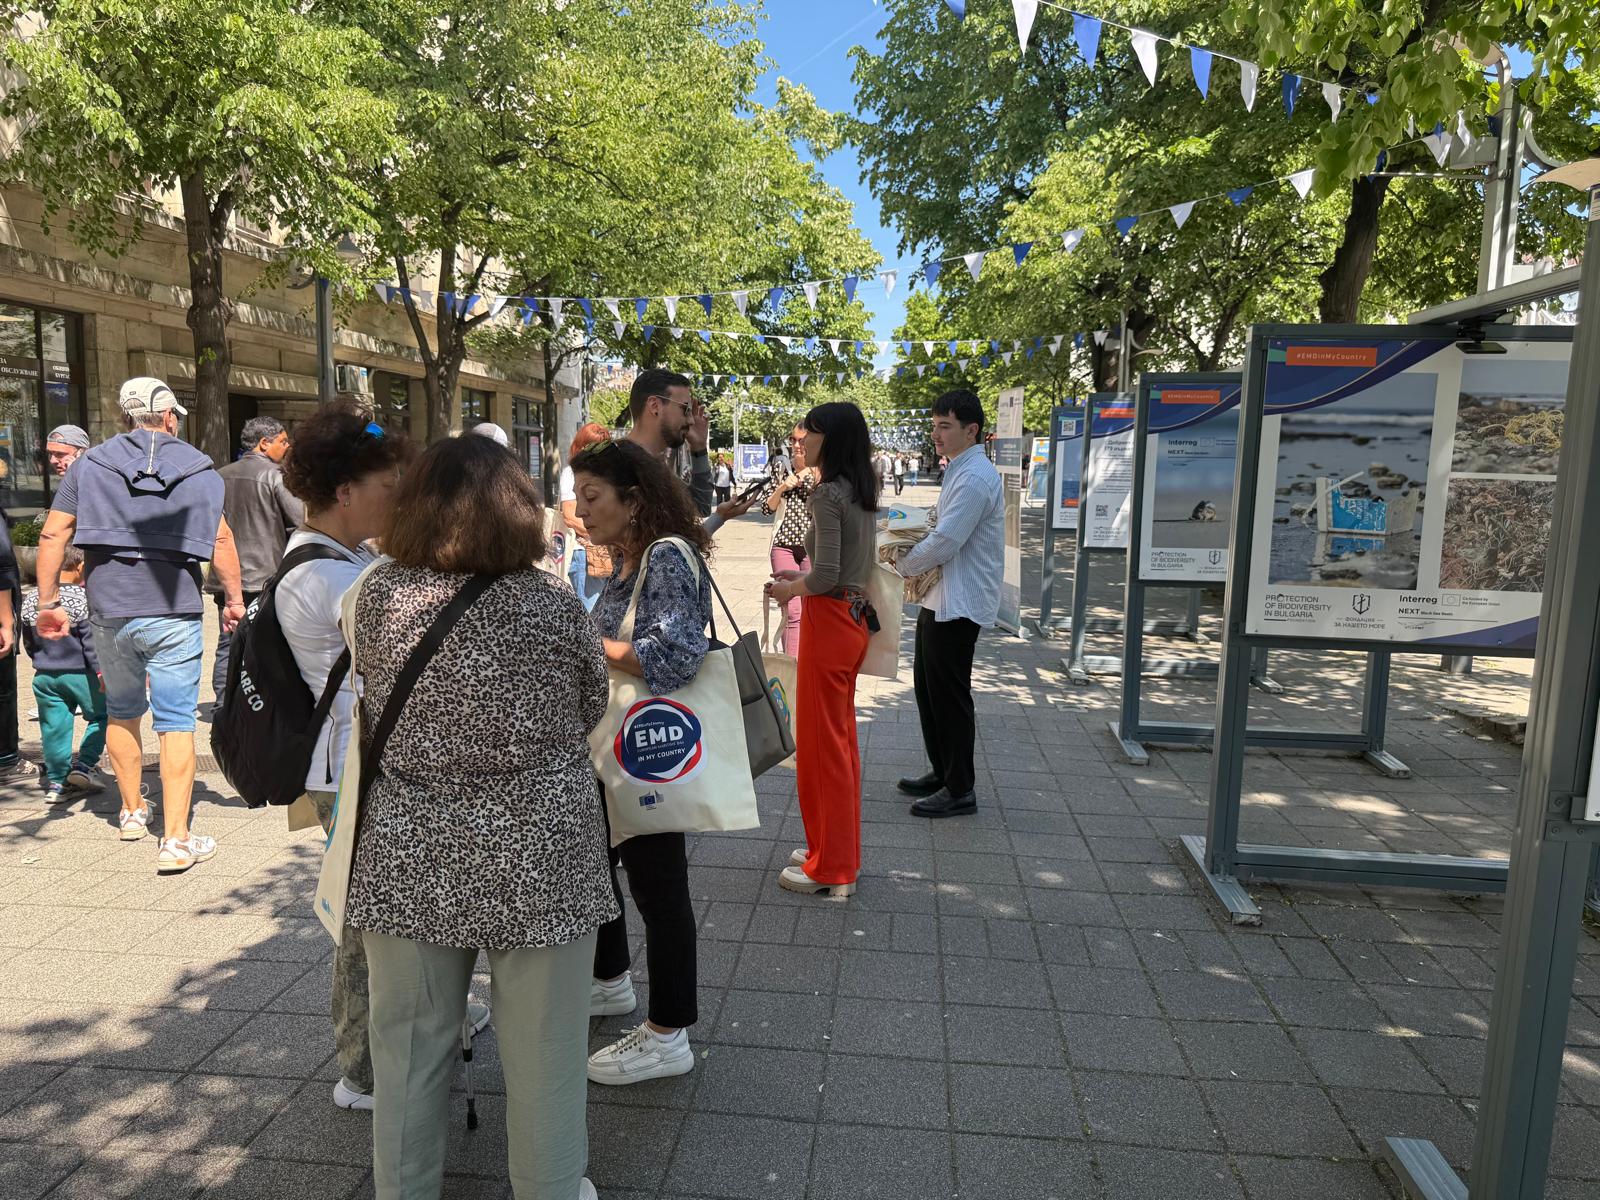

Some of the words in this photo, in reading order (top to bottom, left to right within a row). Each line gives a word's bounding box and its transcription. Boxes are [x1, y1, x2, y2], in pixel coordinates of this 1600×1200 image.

[1168, 439, 1198, 447] Interreg
[1265, 594, 1319, 603] PROTECTION
[1399, 595, 1438, 605] Interreg
[1277, 603, 1332, 612] BIODIVERSITY
[1398, 607, 1421, 615] NEXT
[1264, 609, 1272, 617] IN
[1273, 610, 1313, 618] BULGARIA
[240, 670, 256, 695] ARE
[635, 726, 683, 747] EMD
[657, 748, 686, 758] COUNTRY
